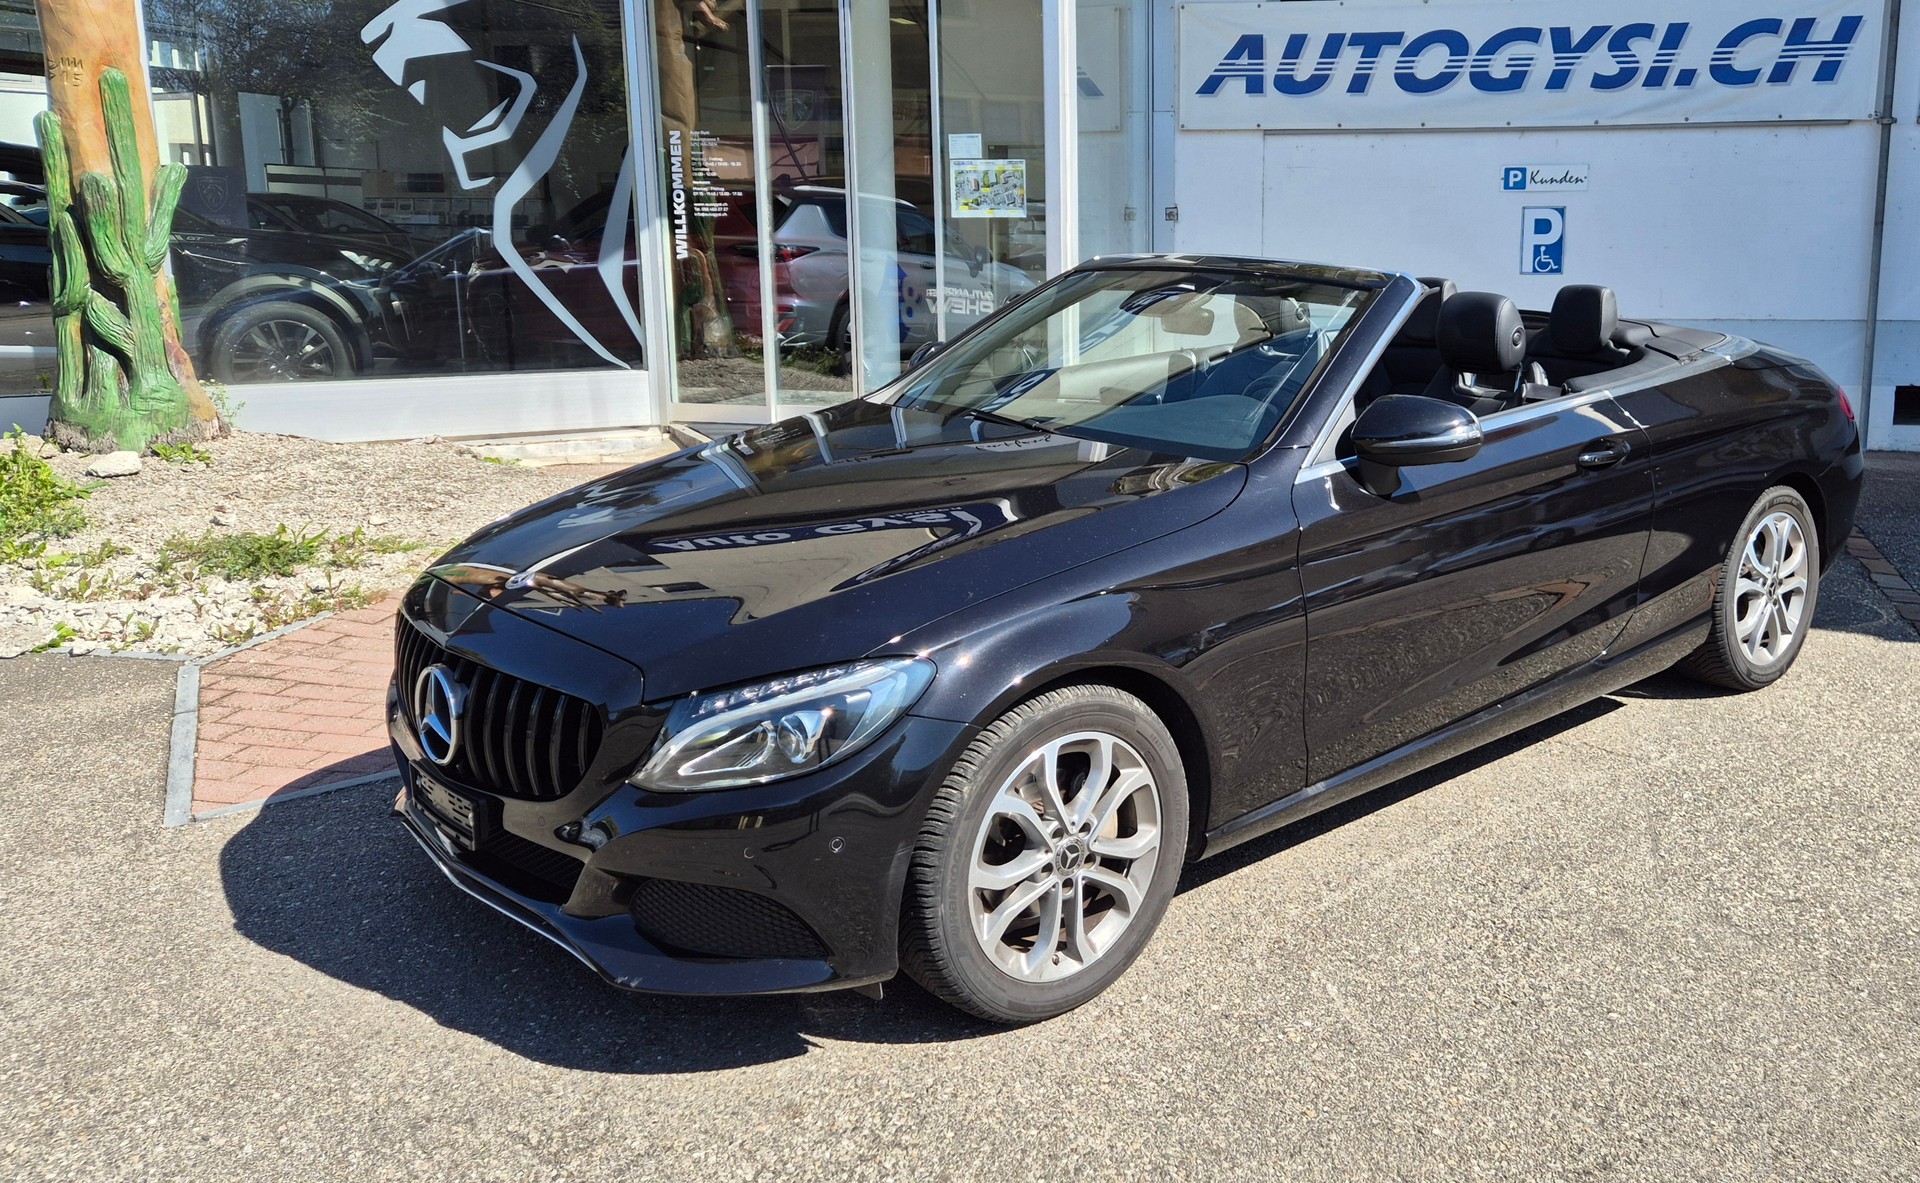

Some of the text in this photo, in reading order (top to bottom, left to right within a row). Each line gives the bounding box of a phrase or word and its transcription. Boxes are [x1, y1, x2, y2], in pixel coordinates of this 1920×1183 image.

[1196, 15, 1866, 97] AUTOGYSI.CH
[669, 130, 688, 259] WILLKOMMEN
[1529, 170, 1584, 184] Kunden
[1522, 208, 1563, 273] P
